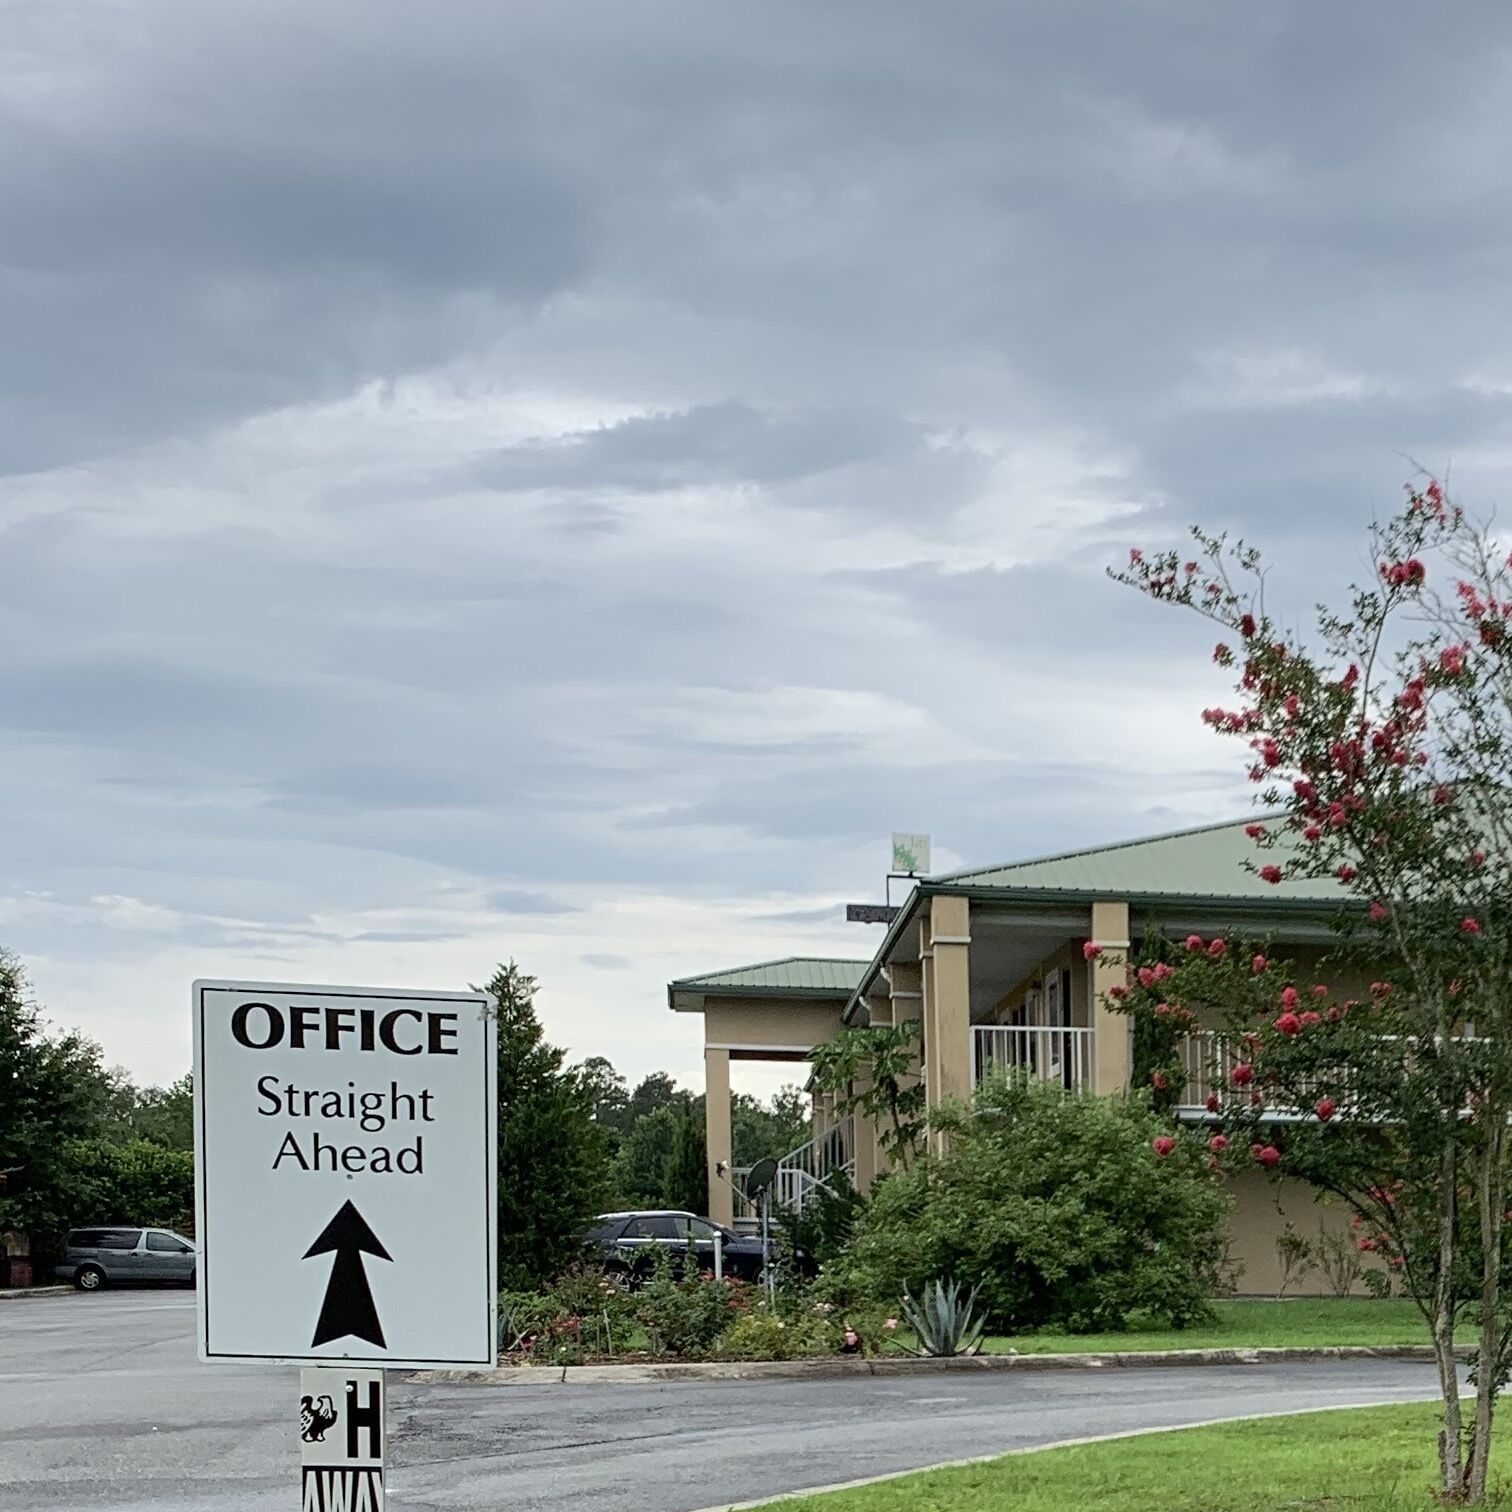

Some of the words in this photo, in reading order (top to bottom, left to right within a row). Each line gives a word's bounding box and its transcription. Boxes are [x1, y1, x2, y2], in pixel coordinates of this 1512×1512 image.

[231, 1002, 459, 1055] OFFICE
[257, 1075, 435, 1132] Straight
[272, 1131, 424, 1175] Ahead
[346, 1381, 381, 1458] H
